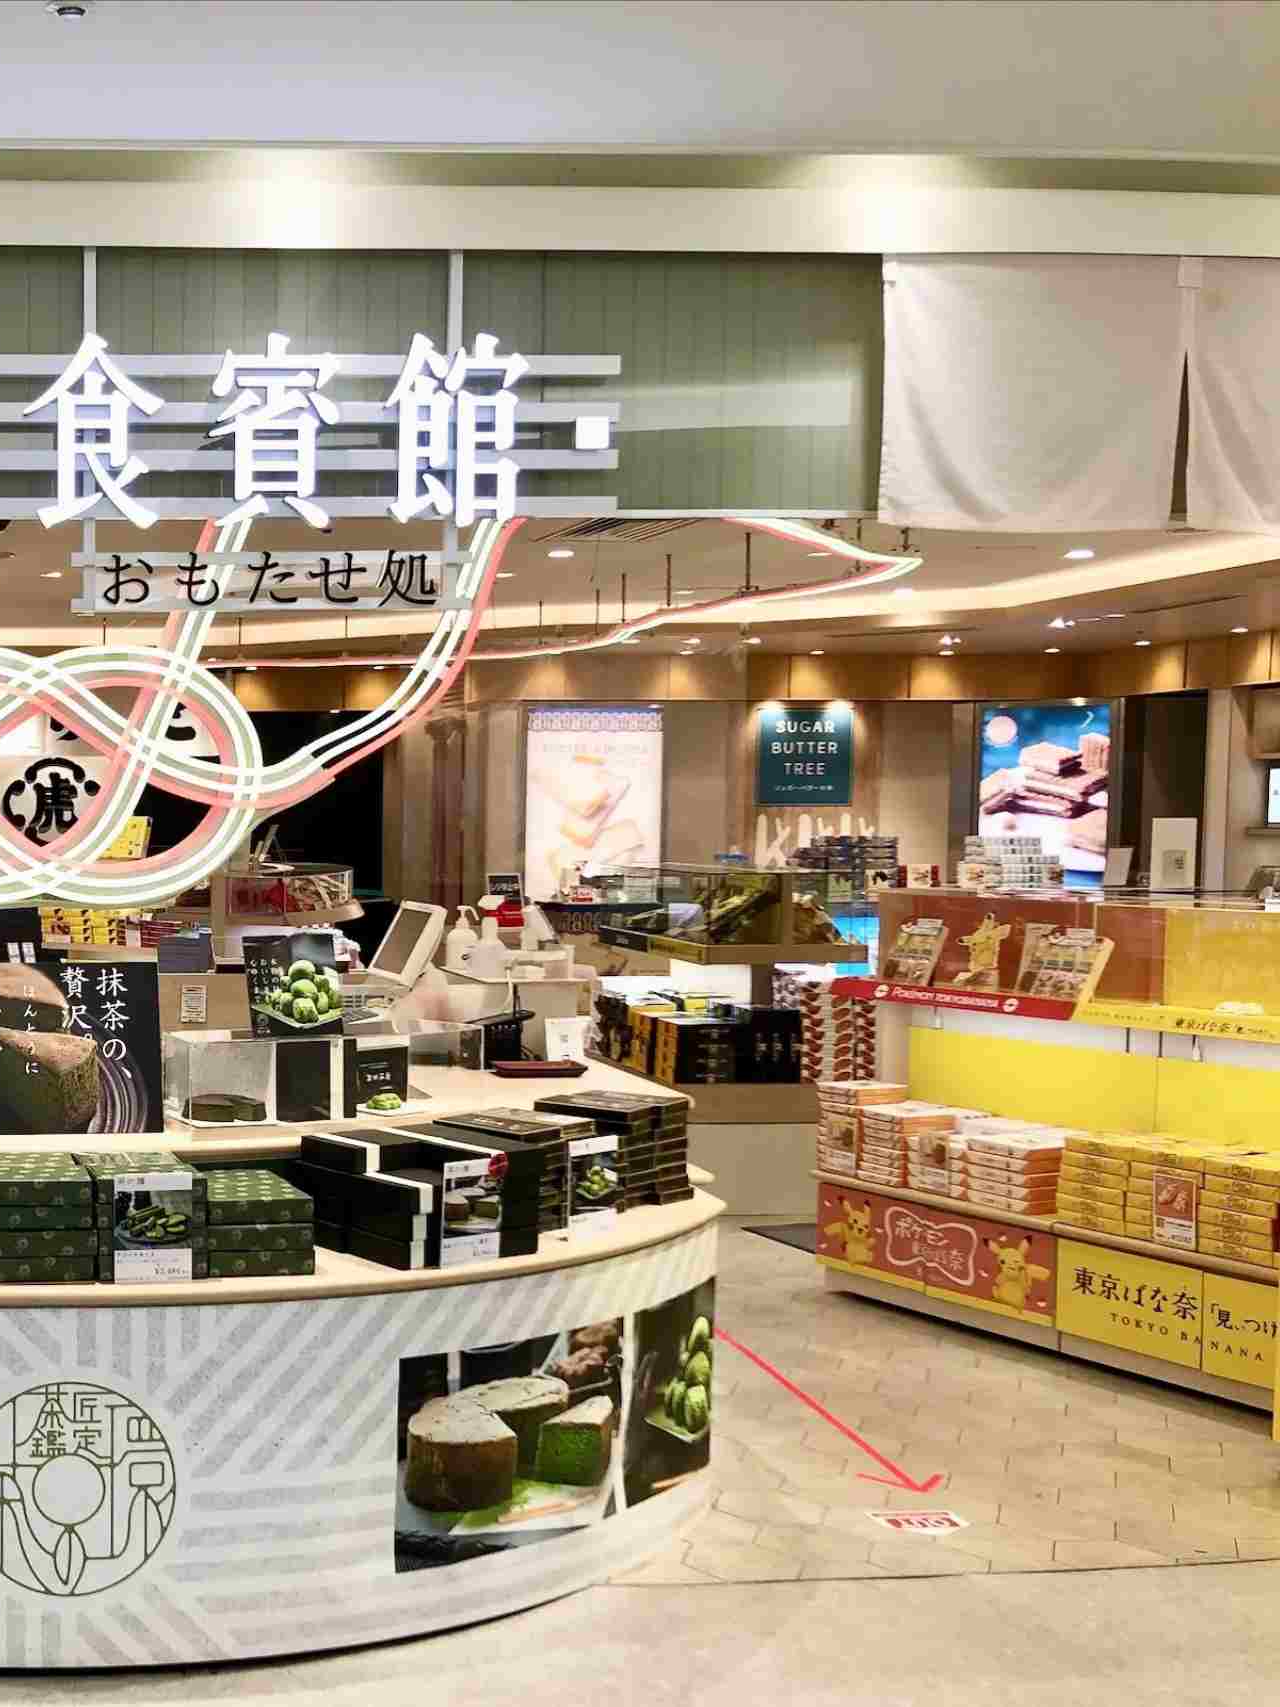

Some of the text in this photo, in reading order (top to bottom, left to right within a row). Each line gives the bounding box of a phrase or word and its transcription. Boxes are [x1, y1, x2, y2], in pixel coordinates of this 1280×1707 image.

[103, 548, 438, 607] おもたせ処
[776, 720, 834, 733] SUGAR
[771, 742, 838, 754] BUTTER
[784, 763, 825, 775] TREE
[1072, 1266, 1198, 1320] 東京ばな奈
[1111, 1312, 1265, 1362] TOKYO BANANA
